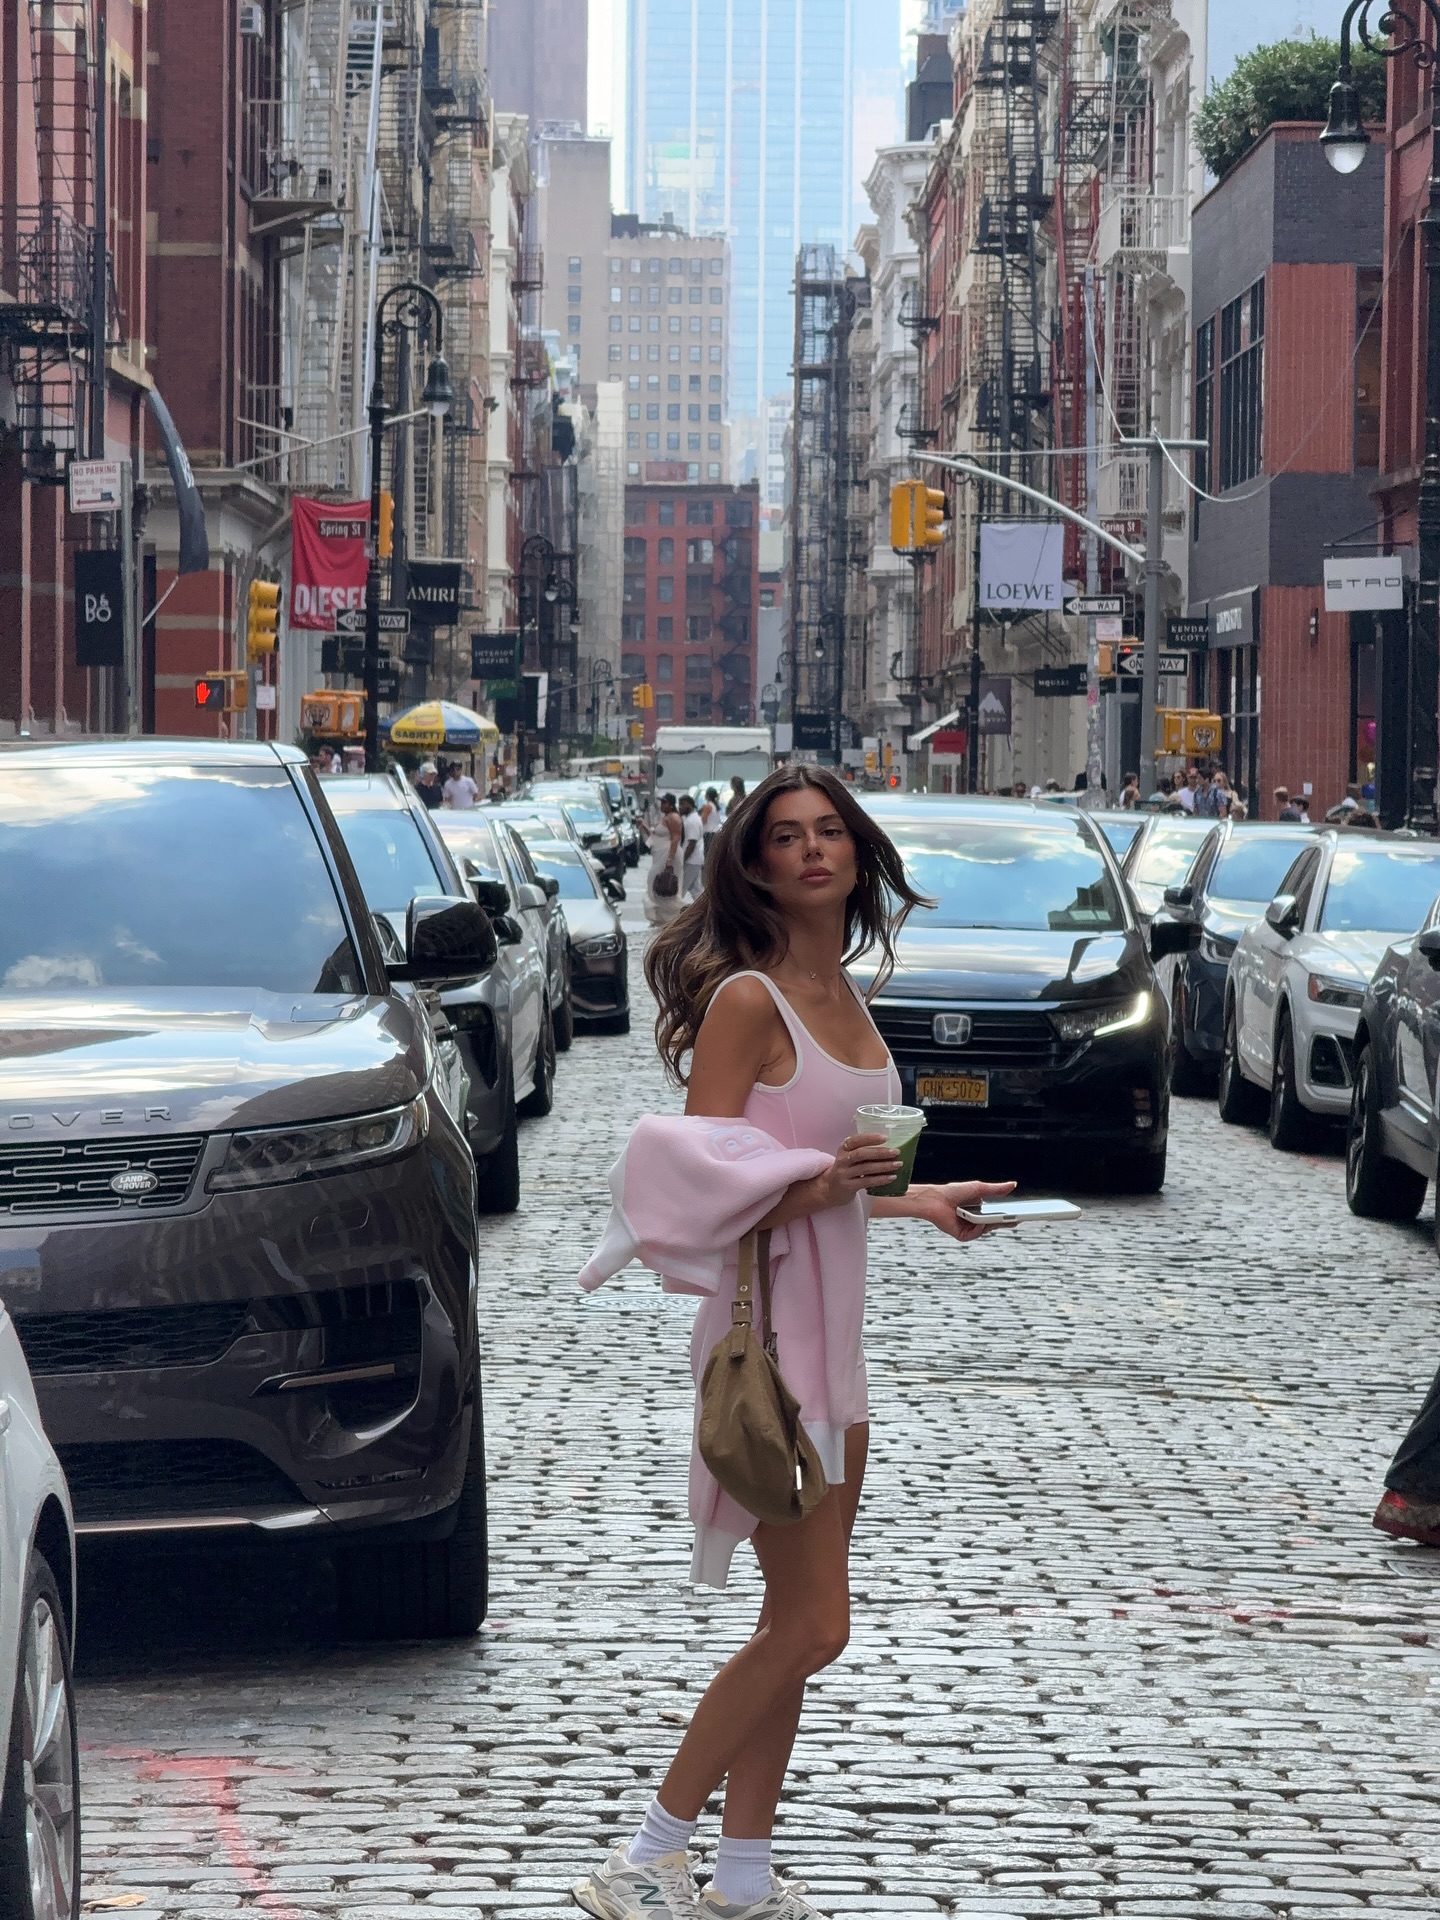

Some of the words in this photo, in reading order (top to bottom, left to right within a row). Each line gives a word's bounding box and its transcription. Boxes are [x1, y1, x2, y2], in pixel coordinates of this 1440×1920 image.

[74, 467, 84, 477] NO
[86, 465, 117, 476] PARKING
[320, 522, 349, 538] Spring
[352, 523, 361, 536] St
[1101, 521, 1125, 534] Spring
[1127, 520, 1136, 532] St
[407, 586, 455, 602] AMIRI
[987, 583, 1055, 601] LOEWE
[1072, 602, 1089, 611] ONE
[1097, 602, 1116, 611] WAY
[379, 615, 403, 628] WAY
[1171, 625, 1209, 634] KENDRA
[1175, 634, 1206, 642] SCOTT
[1129, 660, 1144, 669] ON
[1159, 659, 1180, 669] WAY
[953, 1081, 982, 1099] 5079
[8, 1106, 172, 1130] OVER
[120, 1175, 144, 1183] LAND
[122, 1182, 151, 1190] ROVER
